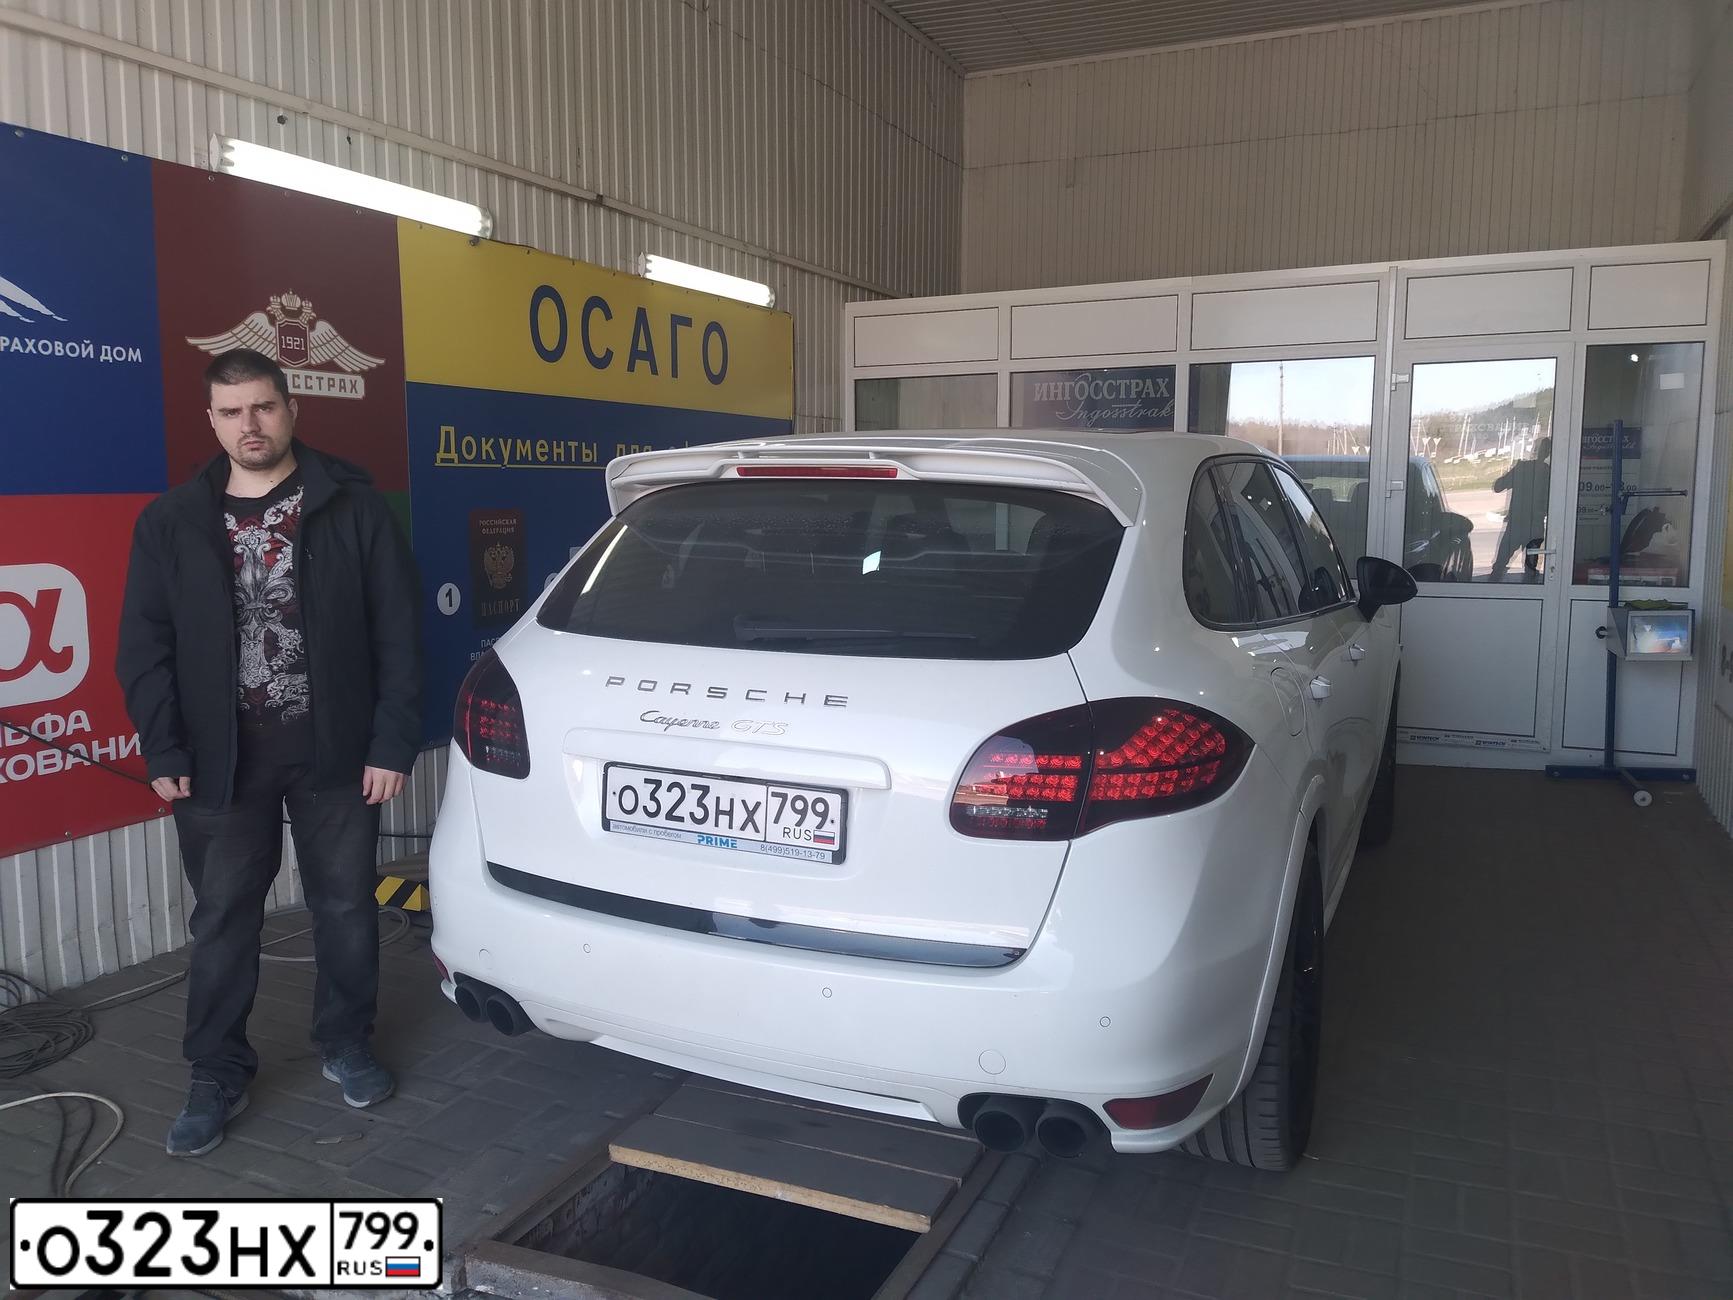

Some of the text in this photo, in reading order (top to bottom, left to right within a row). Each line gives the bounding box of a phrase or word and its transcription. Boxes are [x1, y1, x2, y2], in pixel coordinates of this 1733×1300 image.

[281, 335, 305, 351] 1921
[529, 284, 728, 386] ОСАГО
[99, 344, 143, 363] ДОМ
[1034, 377, 1170, 402] ИНГОССТРАХ
[435, 425, 598, 465] Документы
[481, 598, 520, 617] ПАСПОРТ
[605, 676, 849, 707] PORSCHE
[0, 709, 92, 748] ЬФА
[640, 710, 789, 736] Cayenne GTS
[770, 791, 831, 830] 799
[697, 834, 738, 849] PRIME
[782, 826, 812, 842] RUS
[760, 843, 826, 860] 8(499)519-13-79
